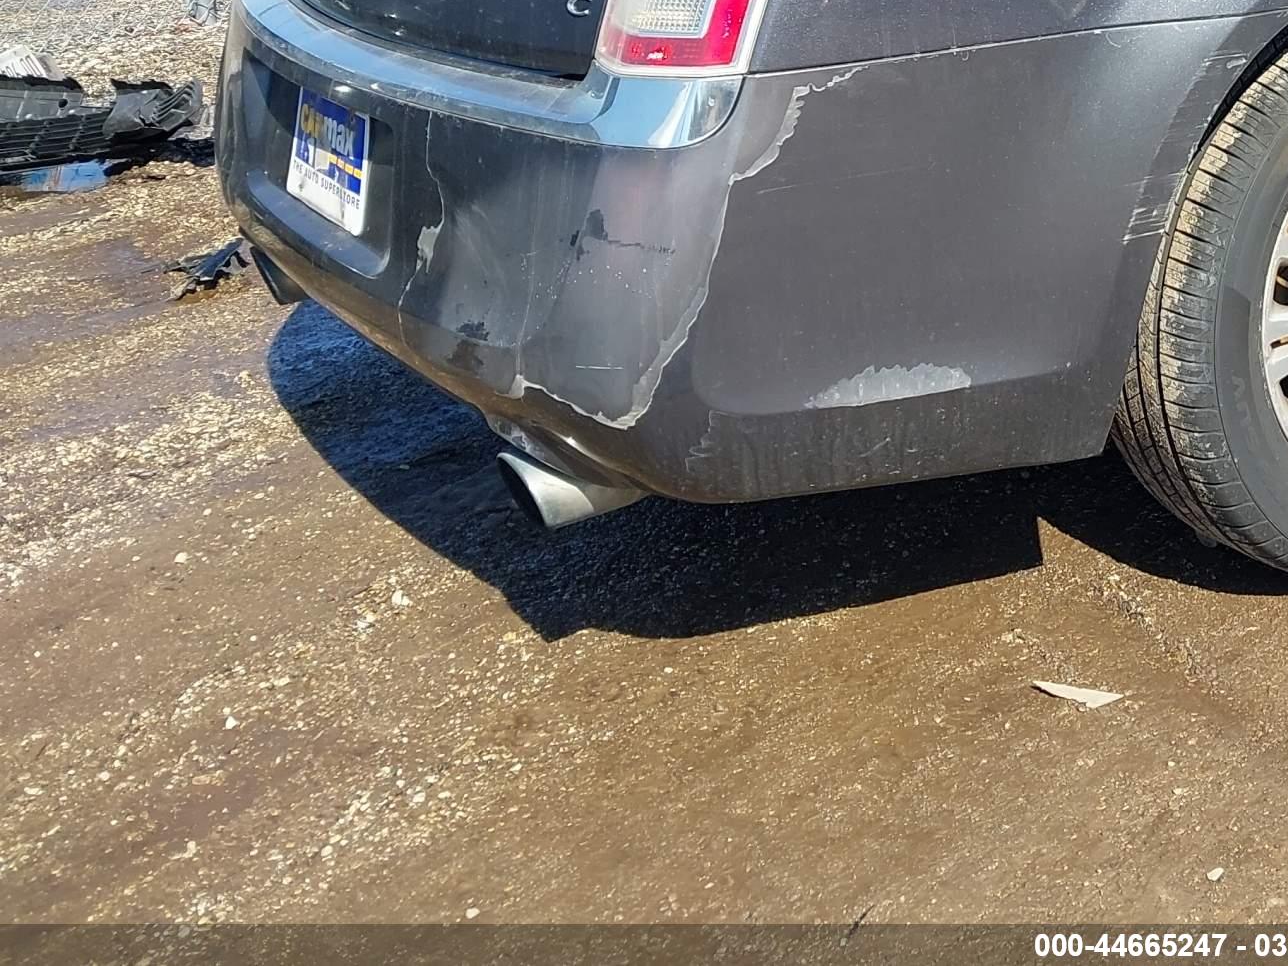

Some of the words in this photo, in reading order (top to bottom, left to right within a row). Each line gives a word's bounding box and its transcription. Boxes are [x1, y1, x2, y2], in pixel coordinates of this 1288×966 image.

[293, 159, 303, 175] THE
[304, 166, 320, 186] AUTO
[320, 177, 361, 211] SUPERSTORE
